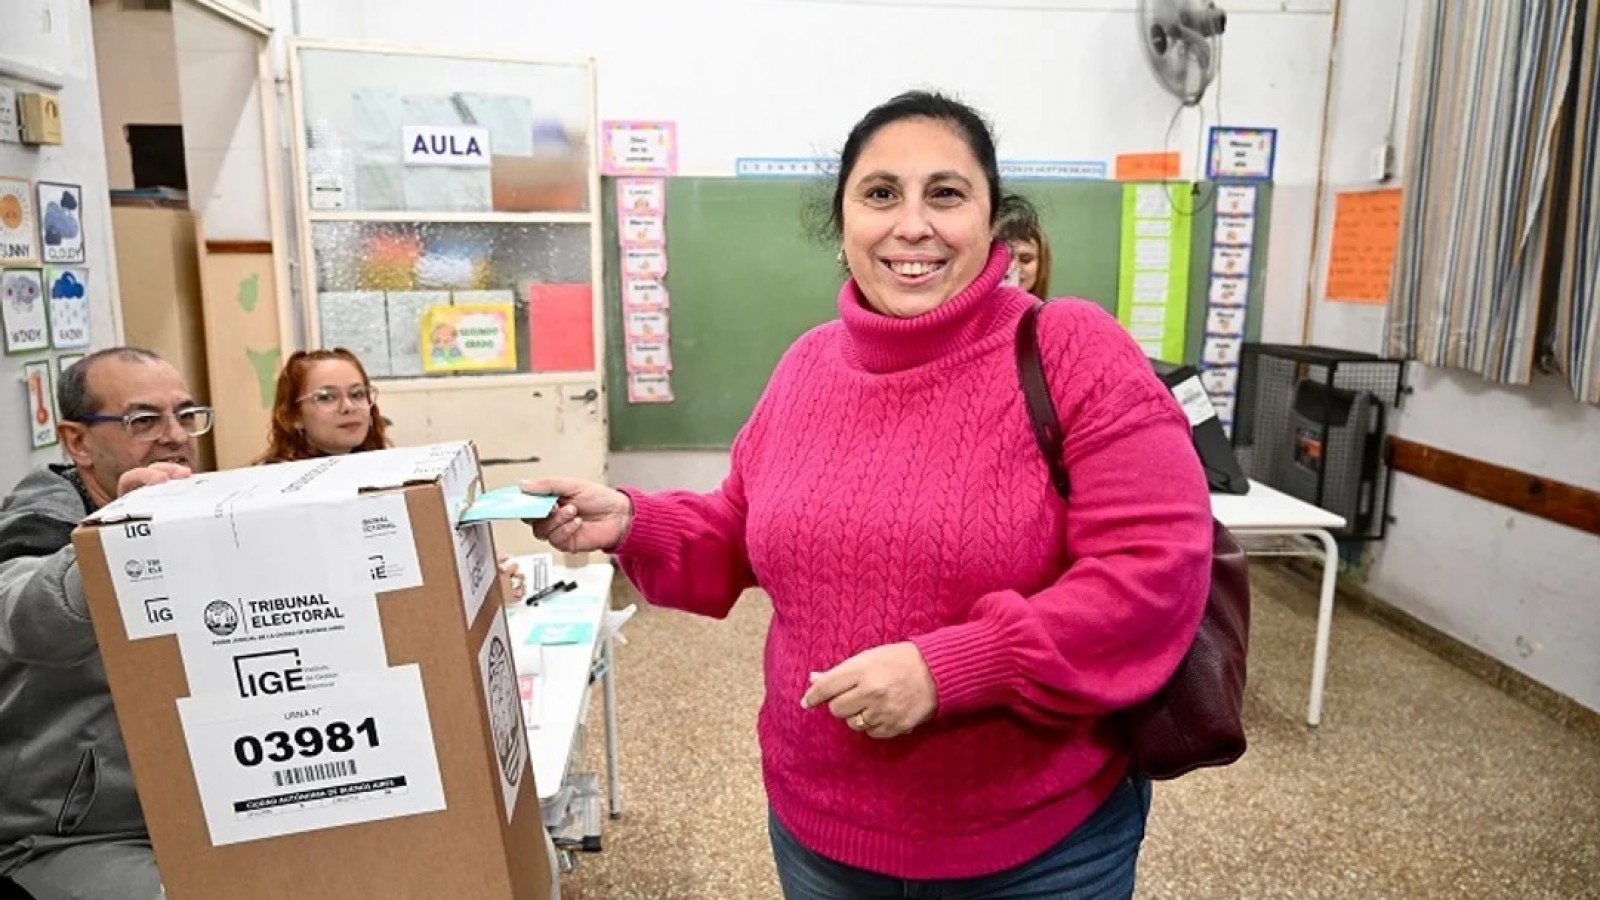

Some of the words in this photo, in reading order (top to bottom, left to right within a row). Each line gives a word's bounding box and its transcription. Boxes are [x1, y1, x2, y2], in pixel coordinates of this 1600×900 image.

[412, 133, 482, 156] AULA
[248, 593, 330, 614] TRIBUNAL
[251, 606, 345, 629] ELECTORAL
[247, 667, 306, 697] IGE
[283, 710, 311, 720] URNA
[233, 716, 380, 768] 03981
[339, 782, 371, 795] BUENOS
